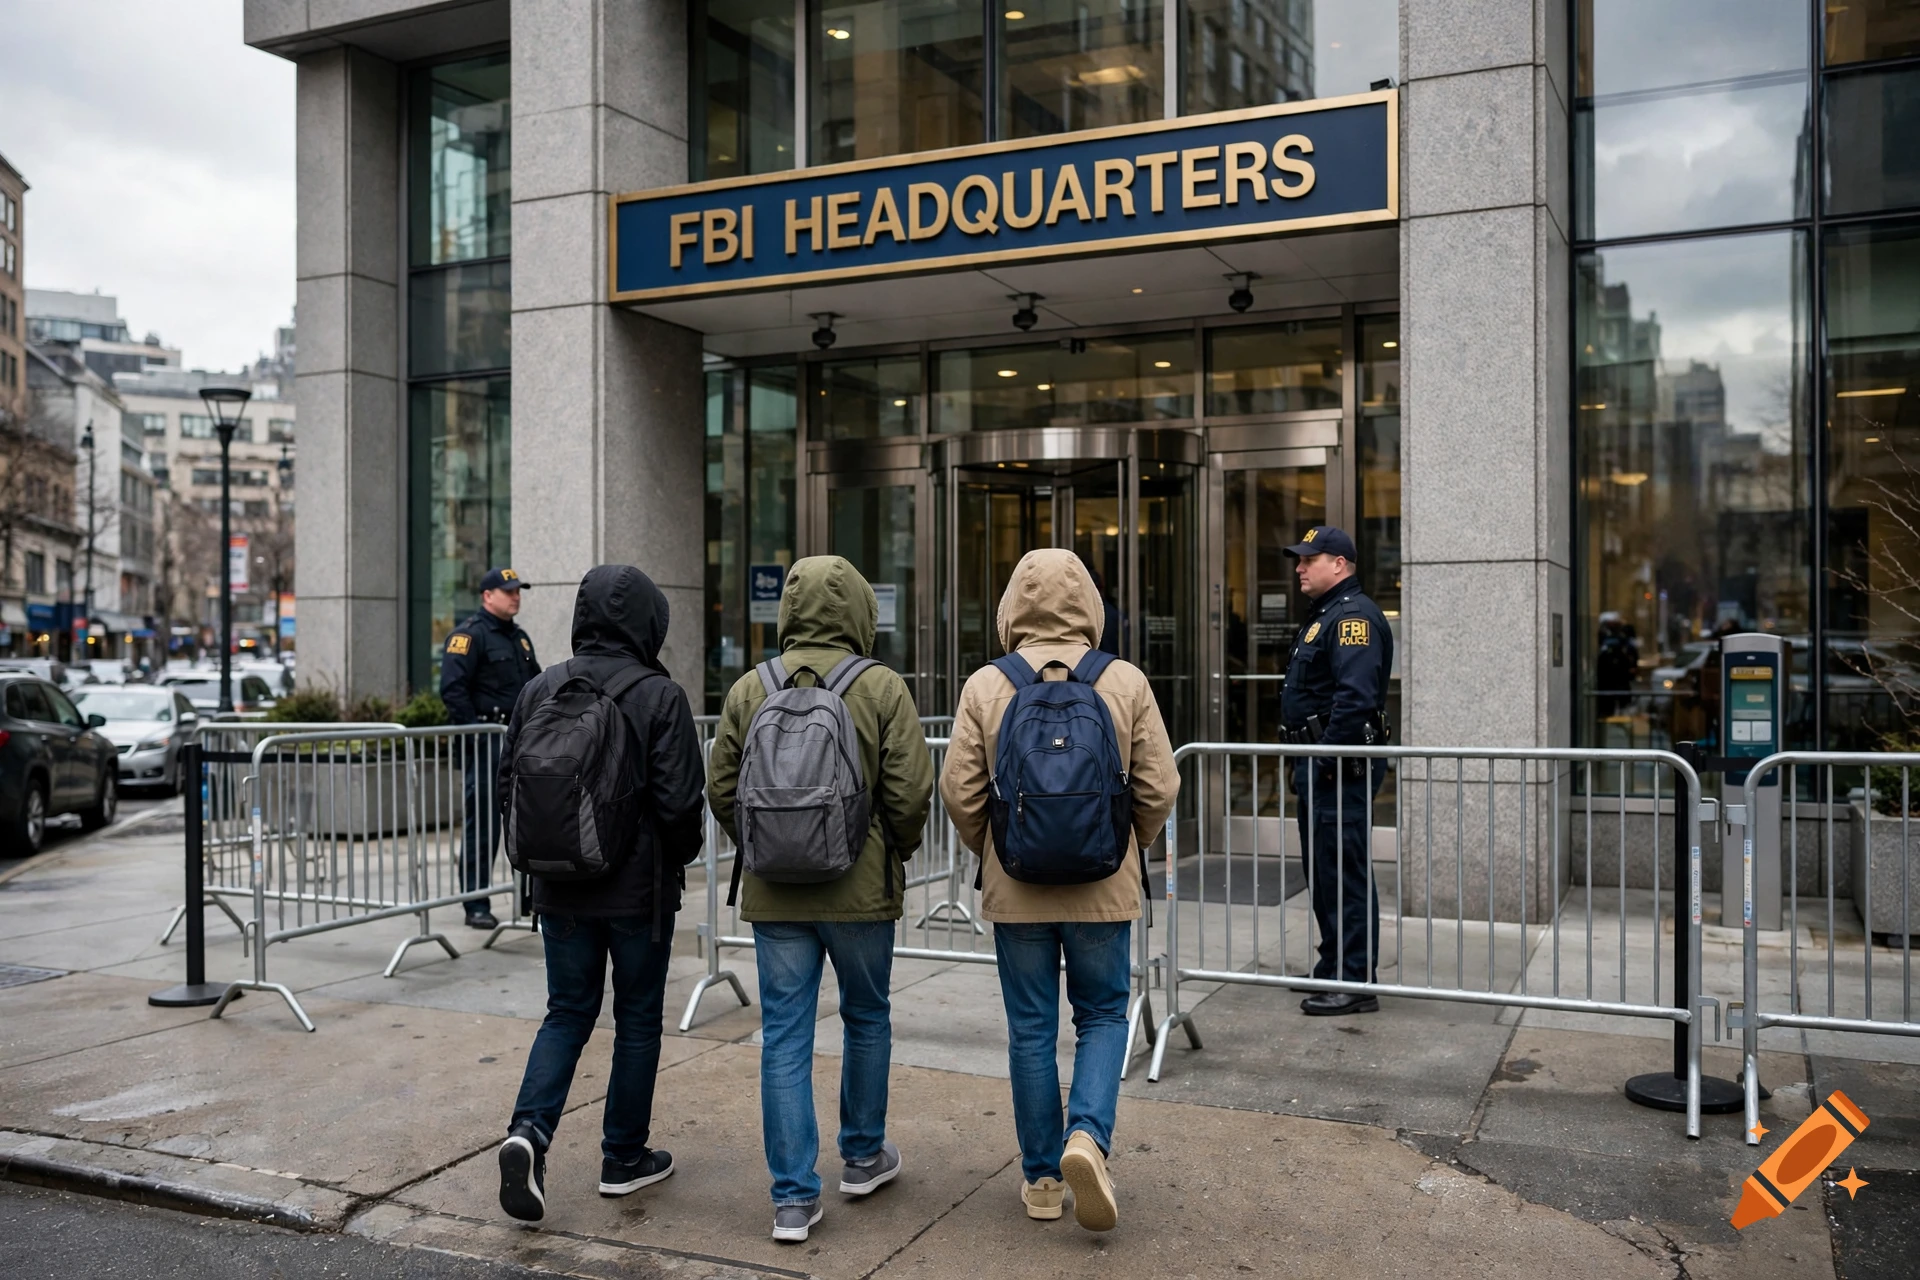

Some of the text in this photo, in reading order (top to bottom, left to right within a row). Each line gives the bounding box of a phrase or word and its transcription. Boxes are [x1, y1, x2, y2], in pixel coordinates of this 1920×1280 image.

[670, 133, 1316, 267] FBI HEADQUARTERS
[1342, 621, 1366, 637] FBI
